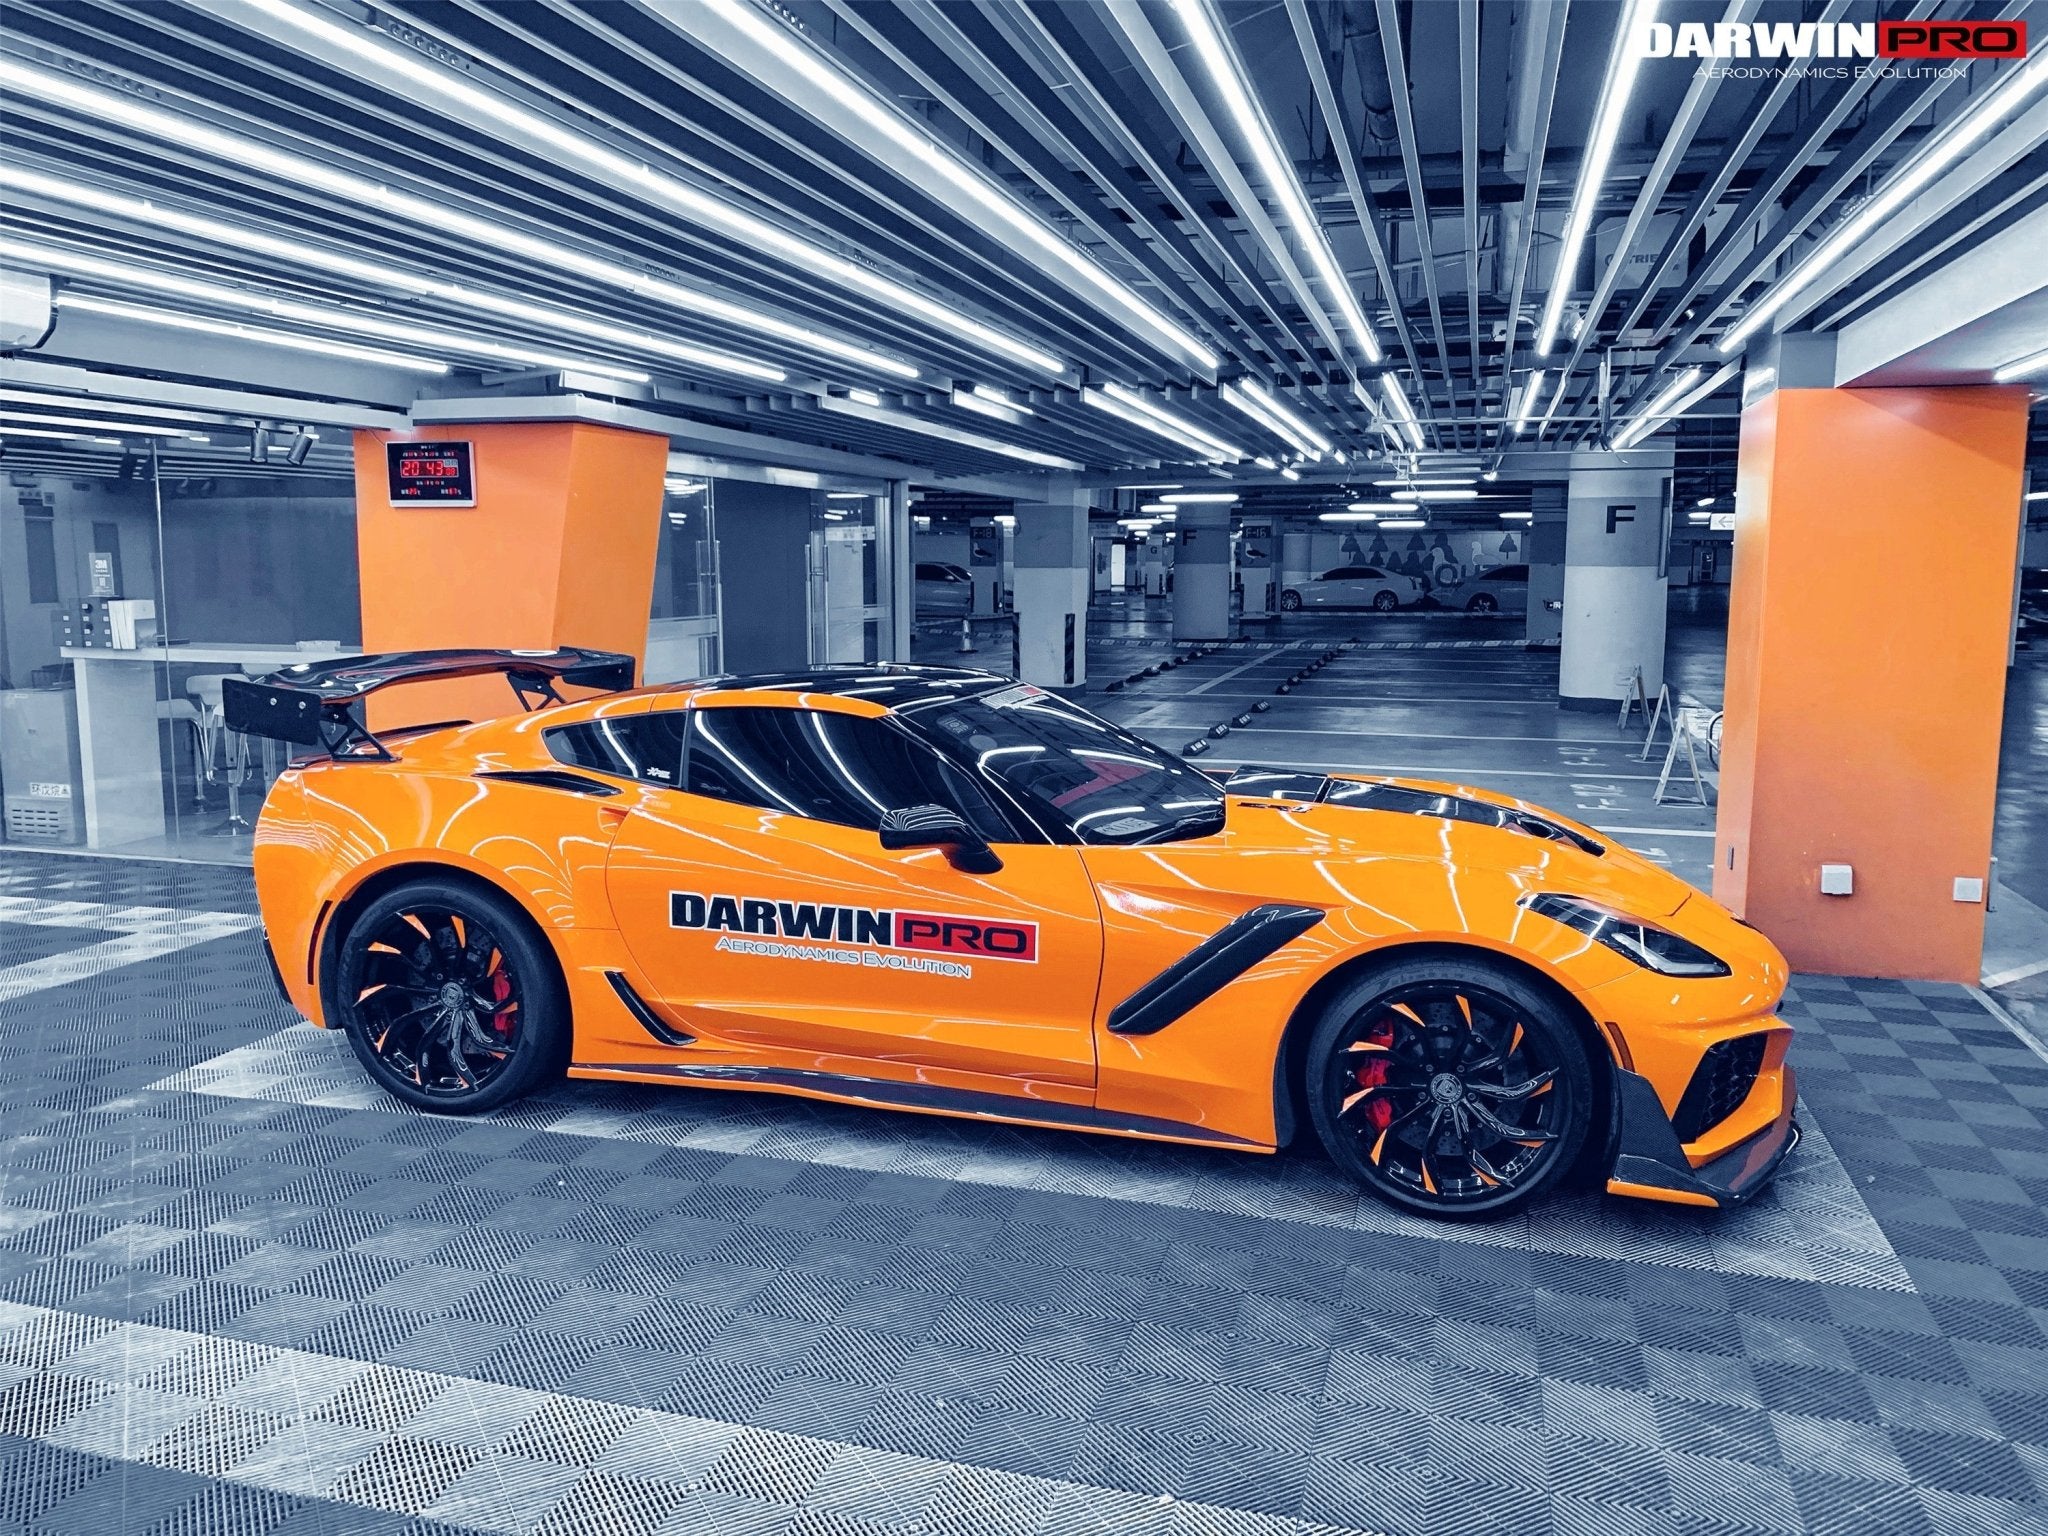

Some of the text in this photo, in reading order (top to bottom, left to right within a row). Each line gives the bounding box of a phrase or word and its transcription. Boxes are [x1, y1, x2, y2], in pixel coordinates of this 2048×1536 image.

[1606, 504, 1637, 534] F
[1182, 529, 1198, 546] F
[1245, 527, 1267, 538] F-16
[1150, 546, 1158, 554] G
[95, 559, 108, 569] 3M
[671, 892, 1028, 954] DARWIN PRO
[716, 937, 971, 978] AERODYNAMICS EVOLUTION
